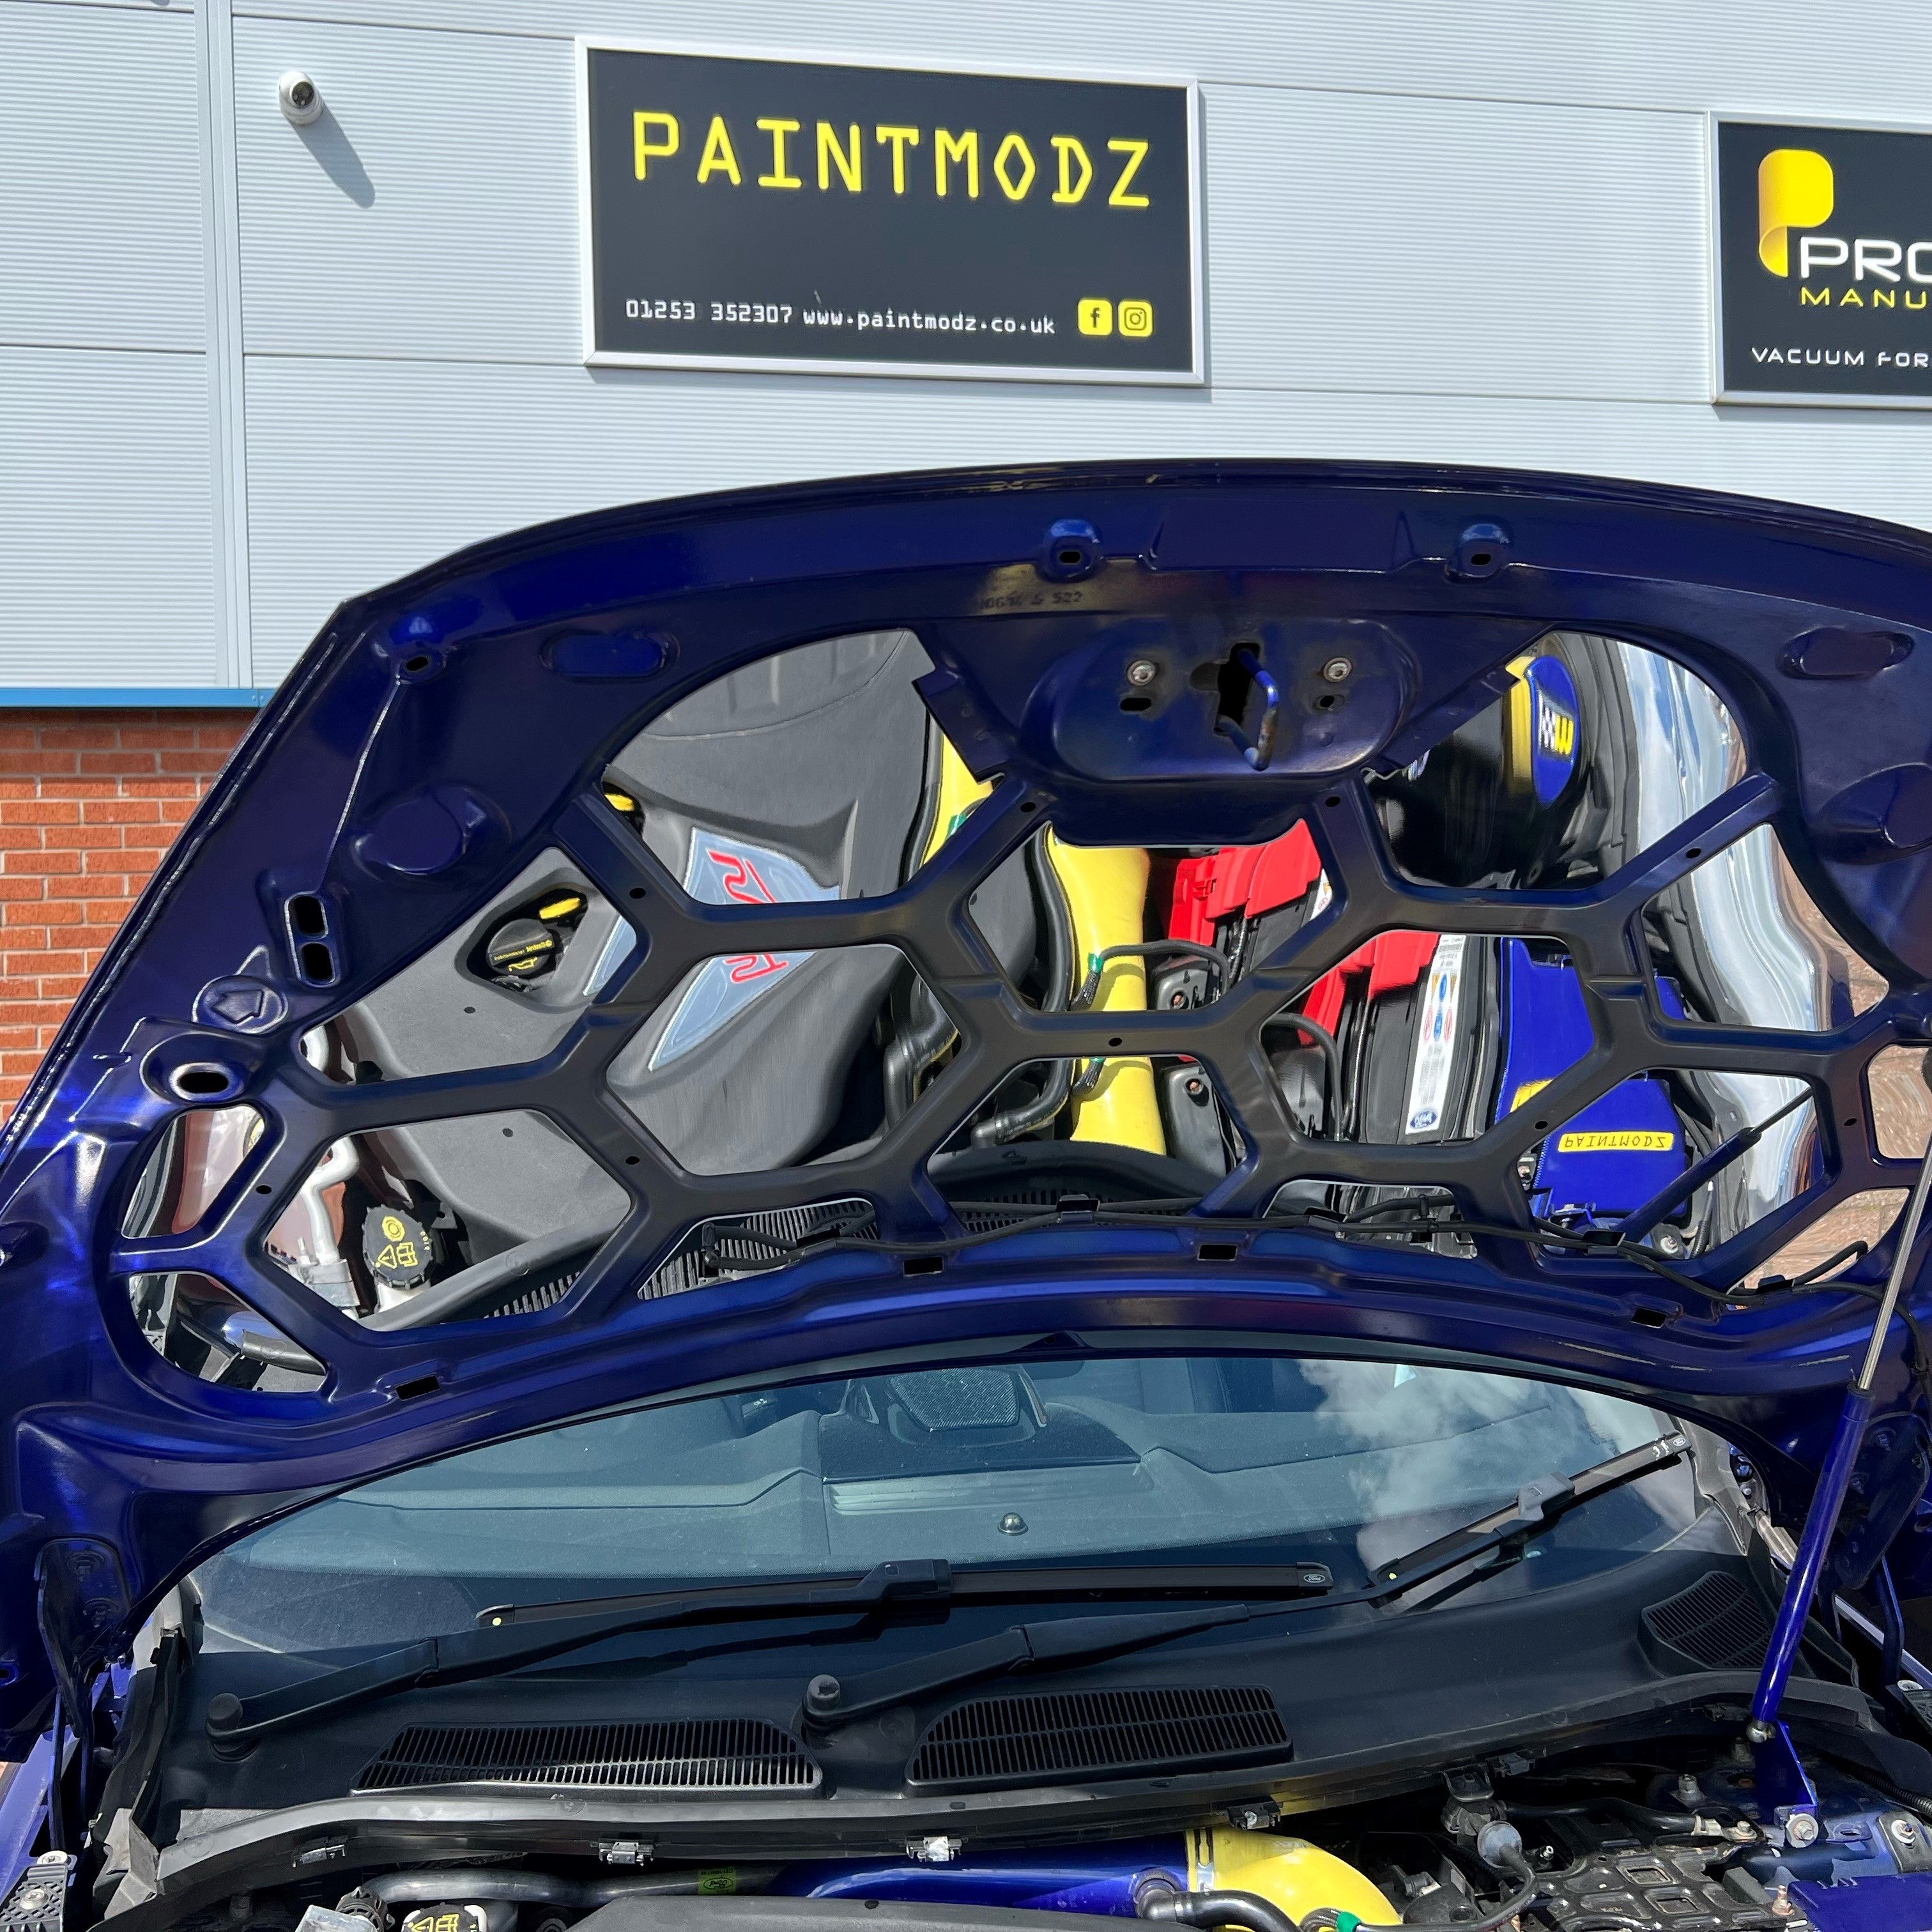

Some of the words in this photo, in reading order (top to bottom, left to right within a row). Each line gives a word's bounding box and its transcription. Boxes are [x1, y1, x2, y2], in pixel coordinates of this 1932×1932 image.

[632, 111, 1151, 208] PAINTMODZ
[1800, 287, 1926, 310] MANU
[625, 299, 696, 321] 01253
[710, 302, 793, 323] 352307
[802, 310, 1055, 335] www.paintmodz.co.uk
[1751, 347, 1864, 366] VACUUM
[1877, 351, 1929, 369] FOR
